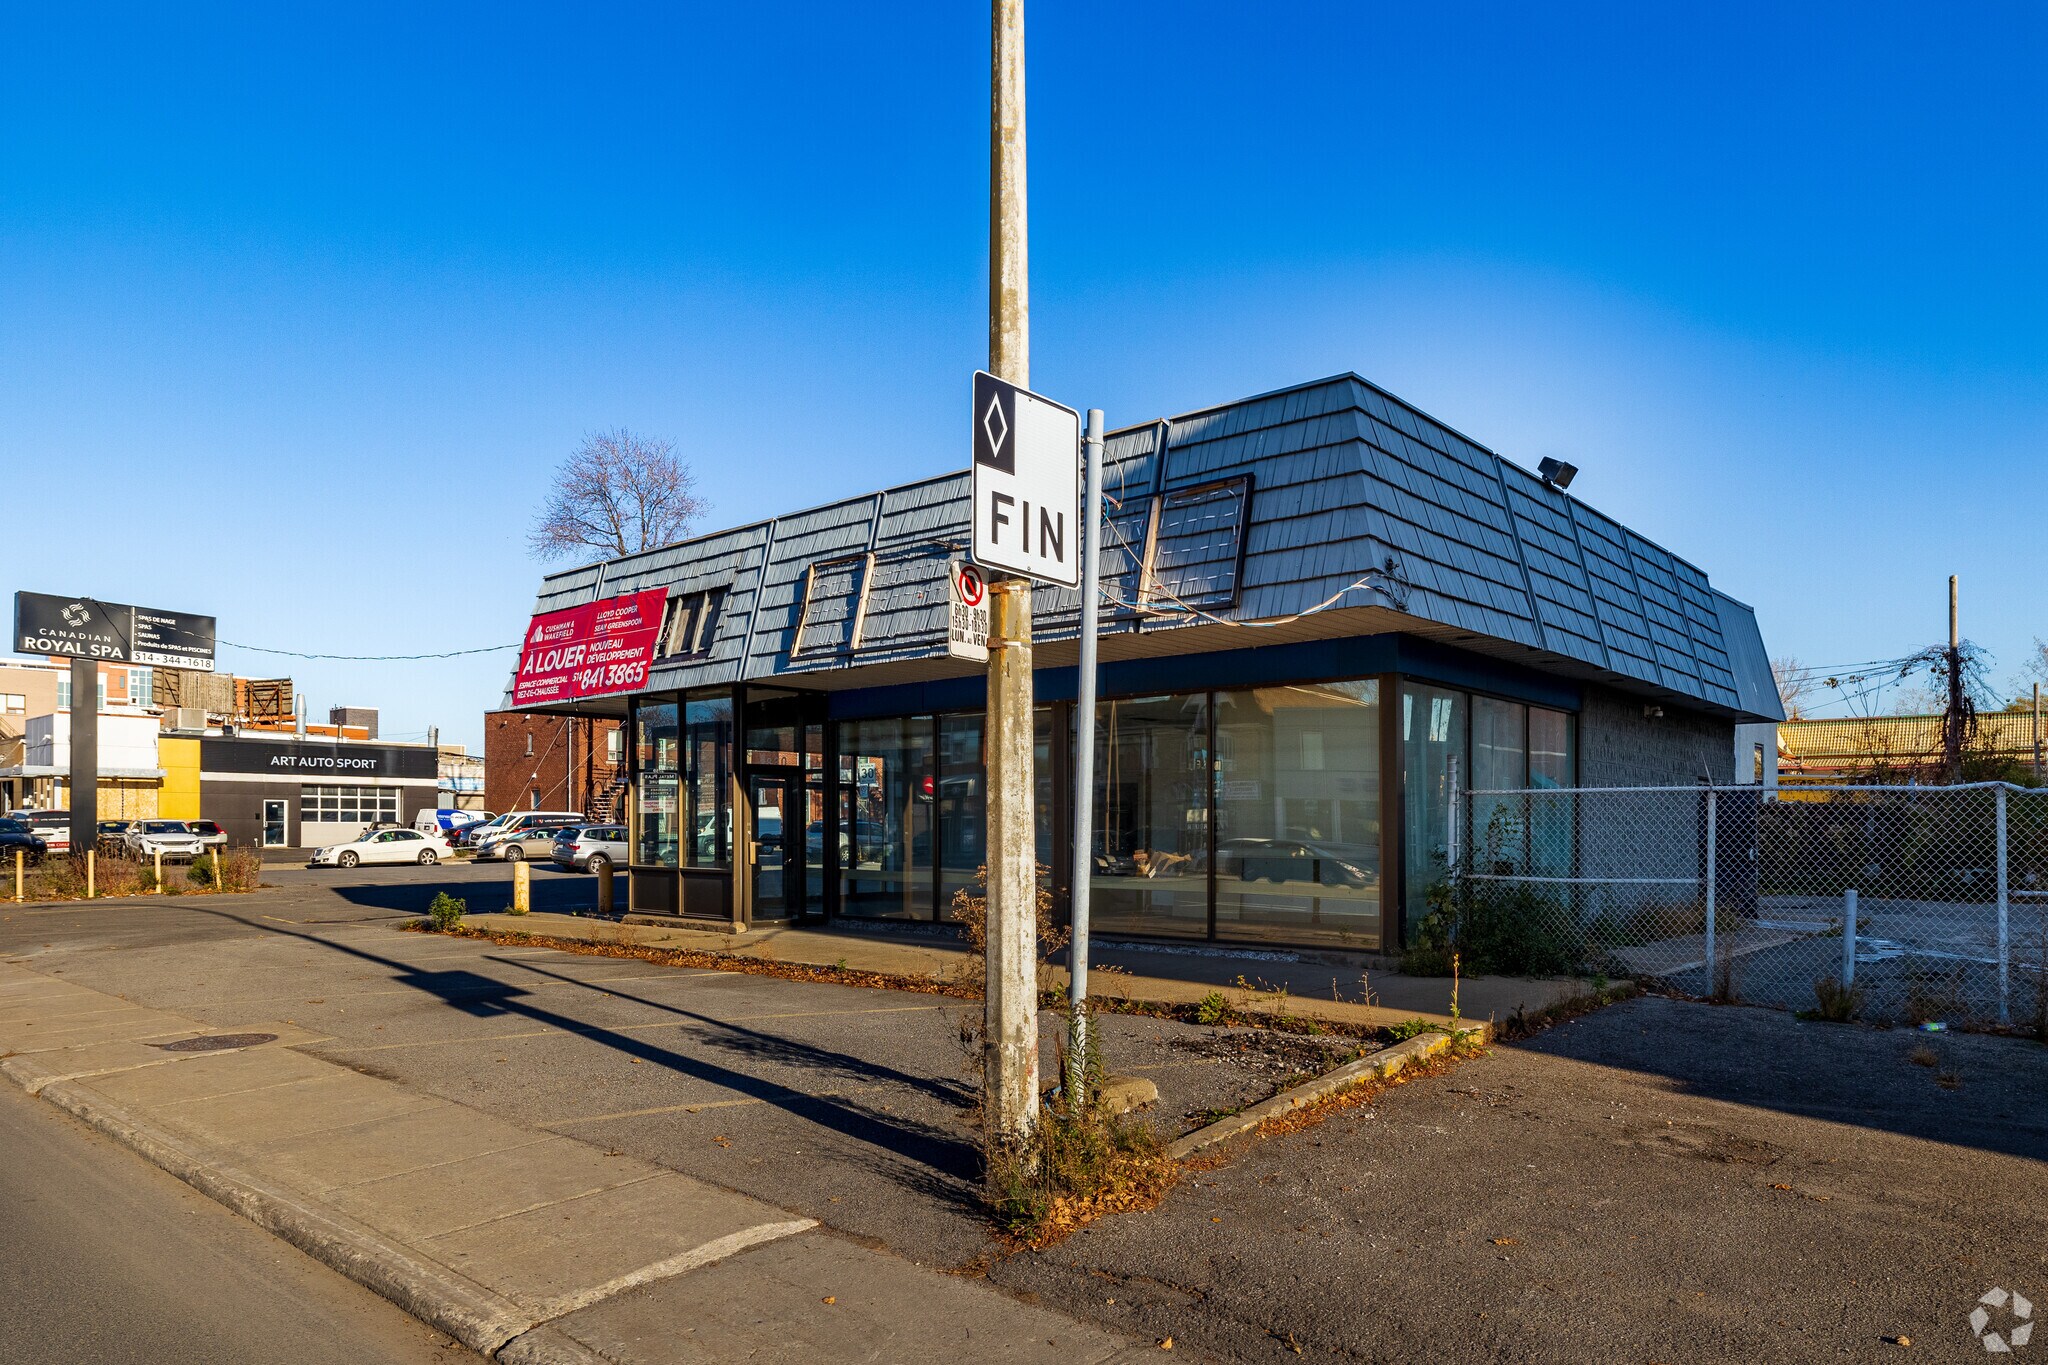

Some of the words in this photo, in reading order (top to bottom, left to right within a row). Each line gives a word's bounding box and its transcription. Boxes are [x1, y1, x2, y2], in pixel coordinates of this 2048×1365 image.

[992, 490, 1063, 563] FIN
[597, 610, 614, 619] LLOYD
[615, 605, 638, 616] COOPER
[545, 622, 570, 633] CUSHMAN
[594, 623, 607, 632] SEAN
[608, 617, 642, 629] GREENSPOON
[39, 628, 111, 642] CANADIAN
[544, 628, 574, 640] WAKEFIELD
[952, 629, 966, 643] LUN.
[25, 636, 86, 655] ROYAL
[90, 644, 124, 659] SPA
[138, 641, 160, 649] Produits
[188, 647, 212, 655] PISCINES
[589, 638, 623, 652] NOUVEAU
[135, 652, 153, 661] 514
[162, 655, 180, 664] 344
[522, 650, 534, 675] À
[535, 645, 587, 673] LOUER
[586, 647, 645, 664] DÉVELOPPEMENT
[518, 679, 537, 689] ESPACE
[537, 675, 568, 686] COMMERCIAL
[572, 671, 583, 682] 514
[270, 756, 297, 766] ART
[299, 757, 334, 767] AUTO
[336, 758, 377, 769] SPORT
[861, 768, 874, 779] 30
